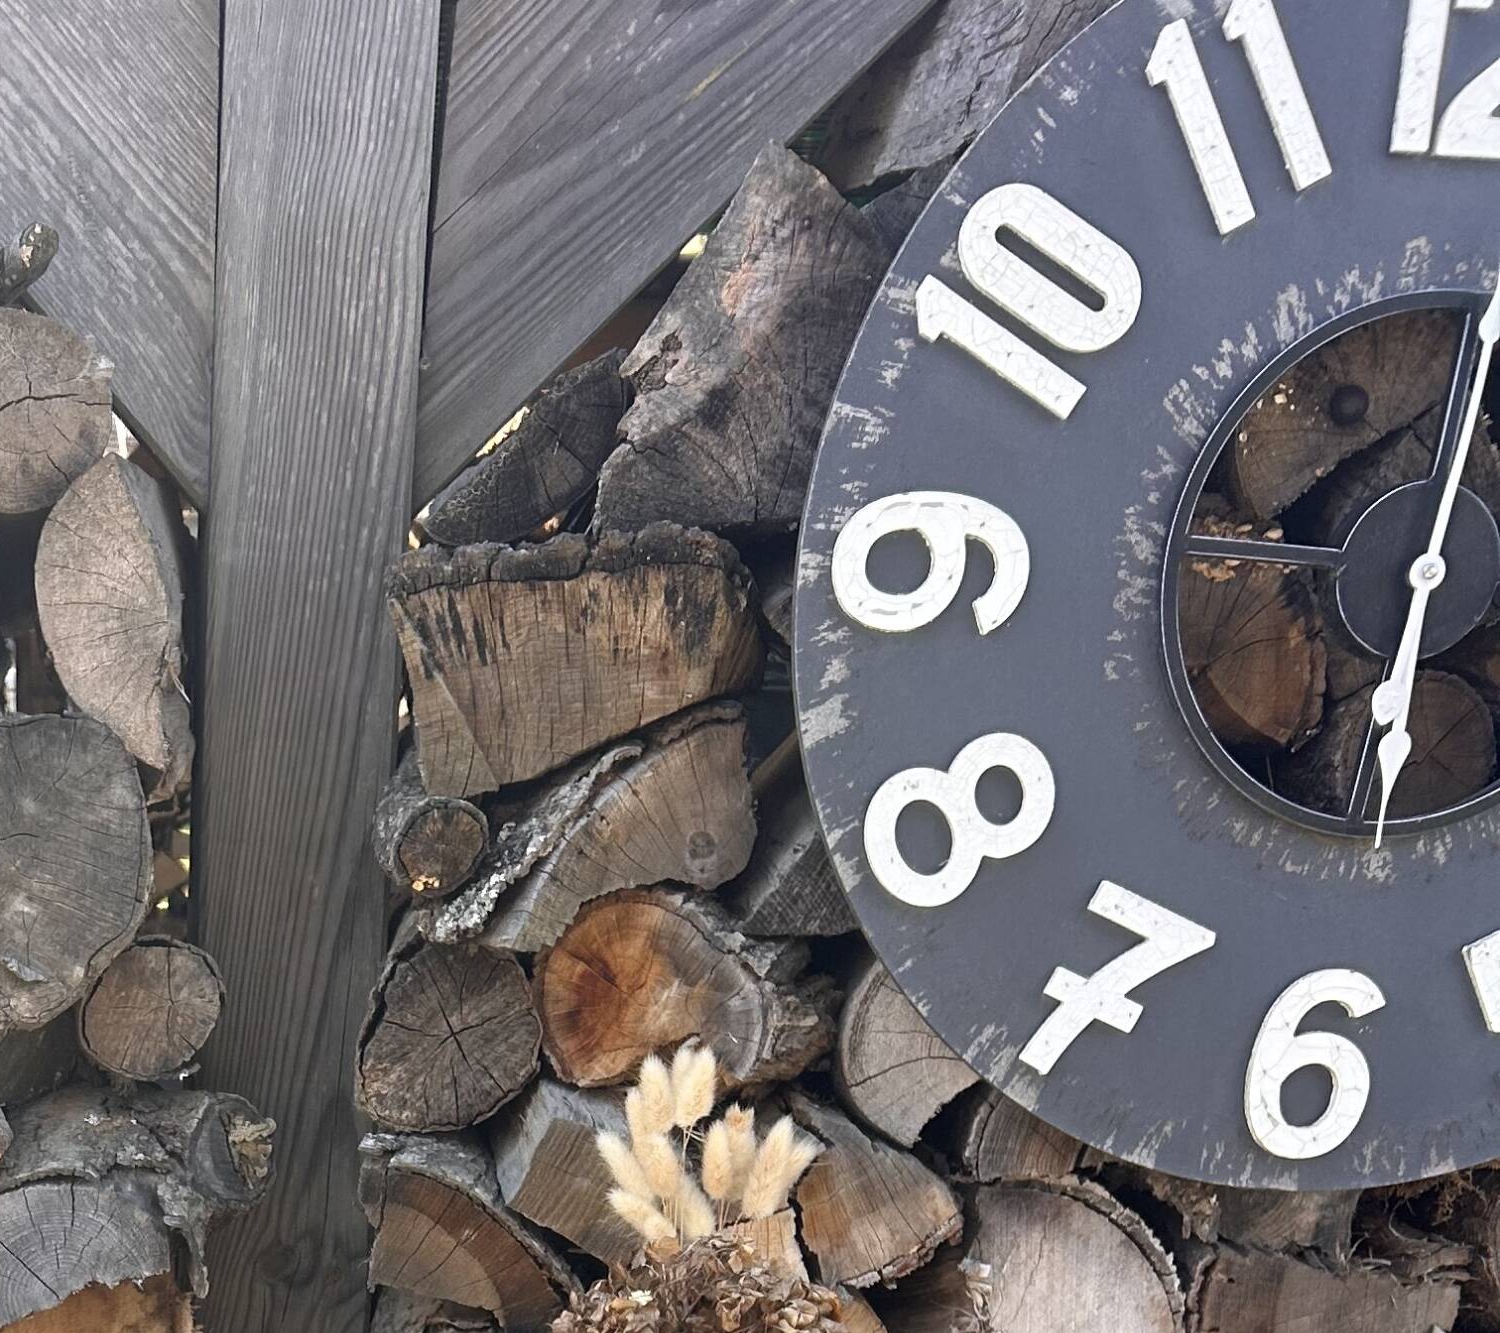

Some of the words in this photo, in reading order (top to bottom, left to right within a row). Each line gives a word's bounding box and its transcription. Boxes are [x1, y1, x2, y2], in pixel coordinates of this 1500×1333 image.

[1145, 0, 1332, 234] 11
[915, 183, 1142, 420] 10
[831, 491, 1030, 635] 9
[863, 733, 1056, 907] 8
[1018, 880, 1216, 1075] 7
[1244, 968, 1387, 1160] 6
